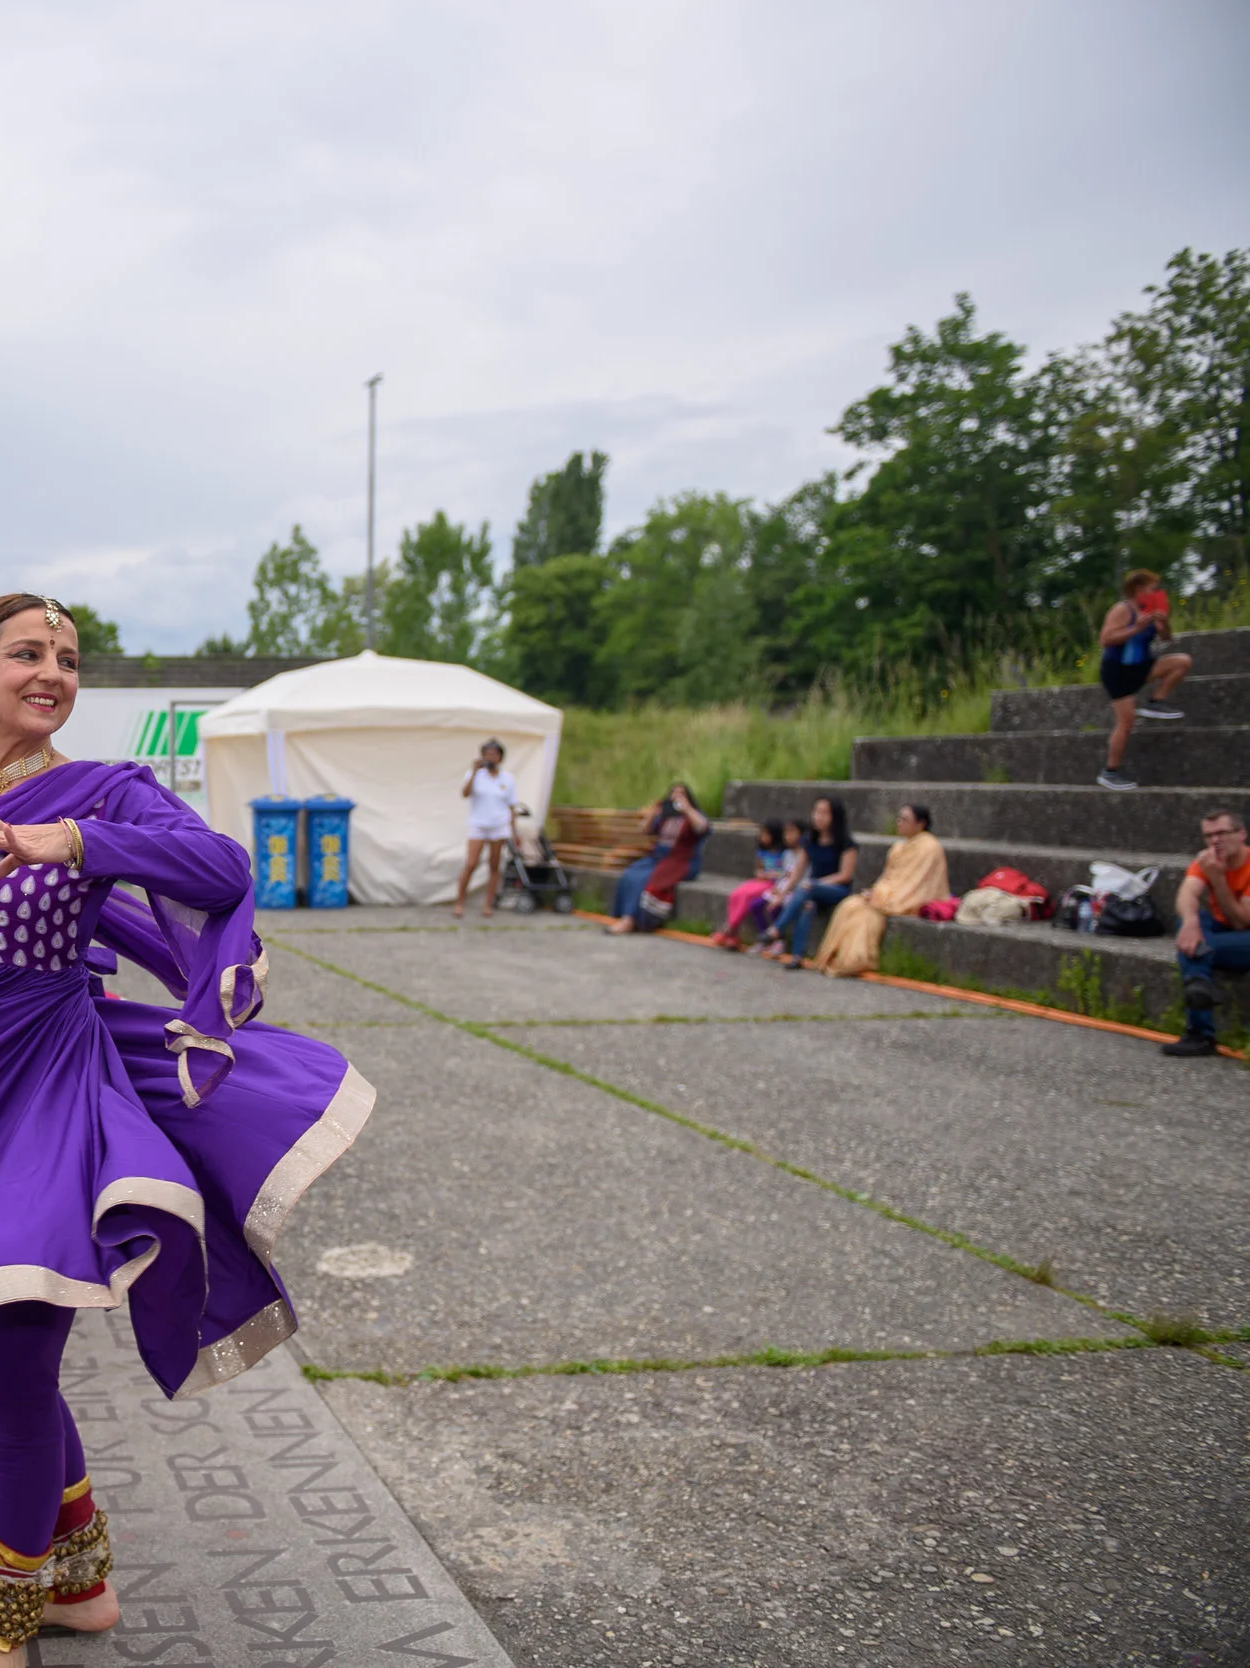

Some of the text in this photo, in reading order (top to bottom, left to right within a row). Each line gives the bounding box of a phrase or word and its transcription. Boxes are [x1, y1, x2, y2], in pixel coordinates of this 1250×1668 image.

[166, 1445, 266, 1521] DER
[237, 1387, 428, 1602] ERKENNEN
[112, 1562, 215, 1668] SEN
